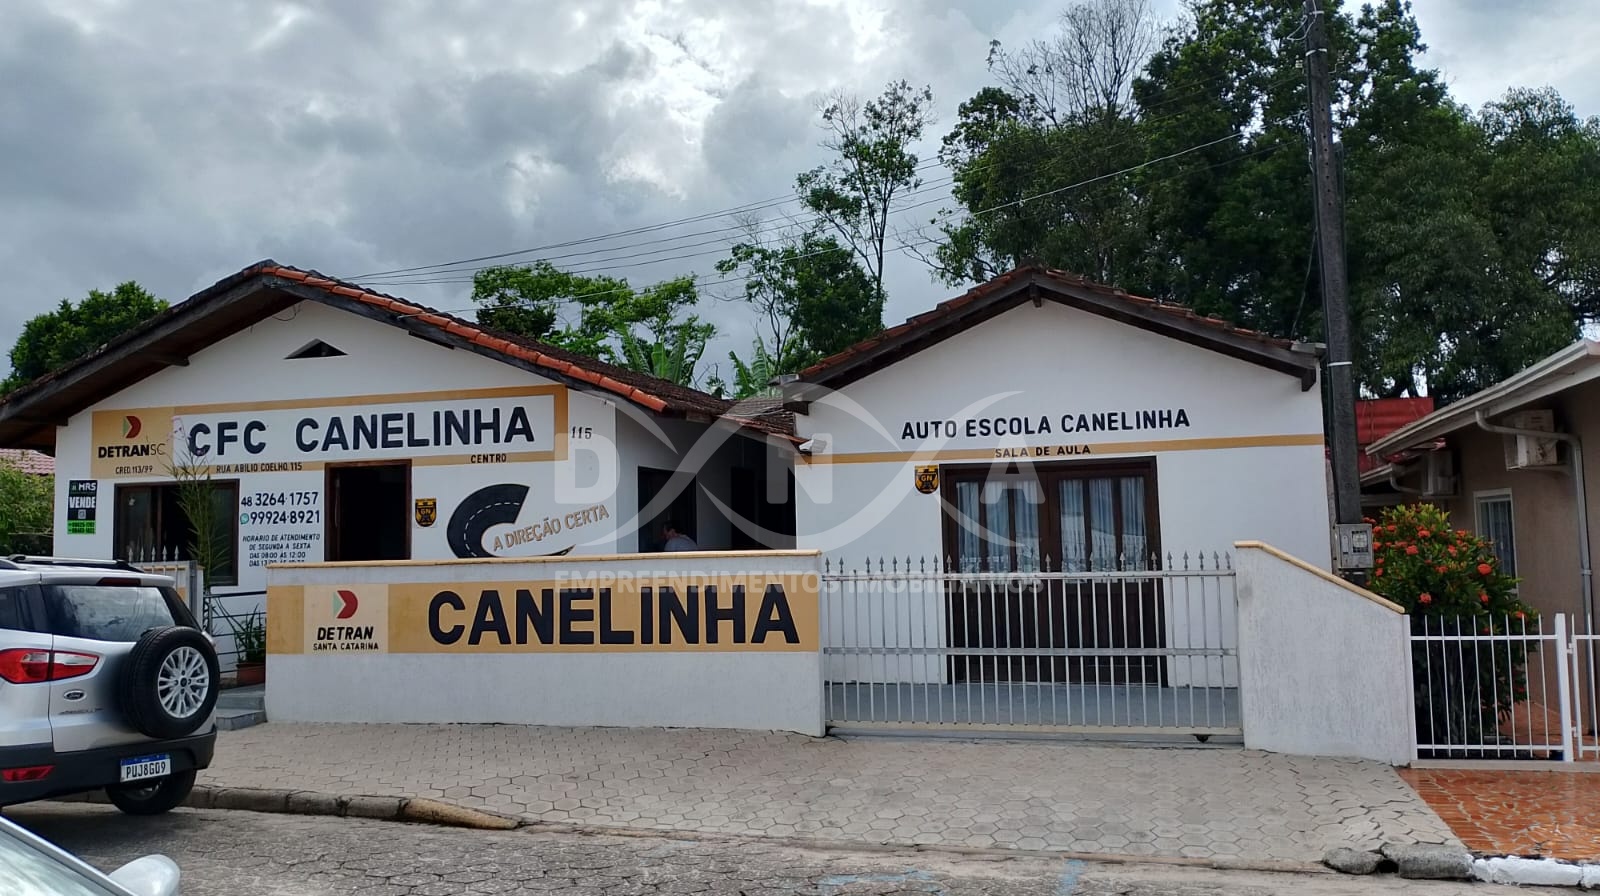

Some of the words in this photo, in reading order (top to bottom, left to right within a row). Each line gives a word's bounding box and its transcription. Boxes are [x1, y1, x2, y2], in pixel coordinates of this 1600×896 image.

[901, 421, 957, 440] AUTO
[965, 415, 1052, 438] ESCOLA
[1061, 408, 1191, 434] CANELINHA
[189, 420, 267, 457] CFC
[296, 406, 535, 453] CANELINHA
[571, 426, 593, 440] 115
[994, 447, 1029, 459] SALA
[1035, 446, 1051, 457] DE
[1056, 444, 1091, 456] AULA
[470, 453, 507, 464] CENTRO
[216, 464, 231, 474] RUA
[290, 461, 303, 472] 115
[79, 482, 97, 491] MRS
[69, 496, 96, 509] VENDE
[240, 496, 253, 507] 48
[493, 535, 504, 552] A
[504, 517, 562, 549] DIREÇÃO
[564, 504, 610, 530] CERTA
[271, 534, 279, 542] DE
[280, 533, 321, 541] ATENDIMENTO
[249, 543, 256, 551] DE
[292, 542, 311, 550] SEXTA
[428, 583, 800, 646] CANELINHA
[317, 626, 374, 641] DETRAN
[313, 642, 338, 651] SANTA
[340, 642, 379, 651] CATARINA
